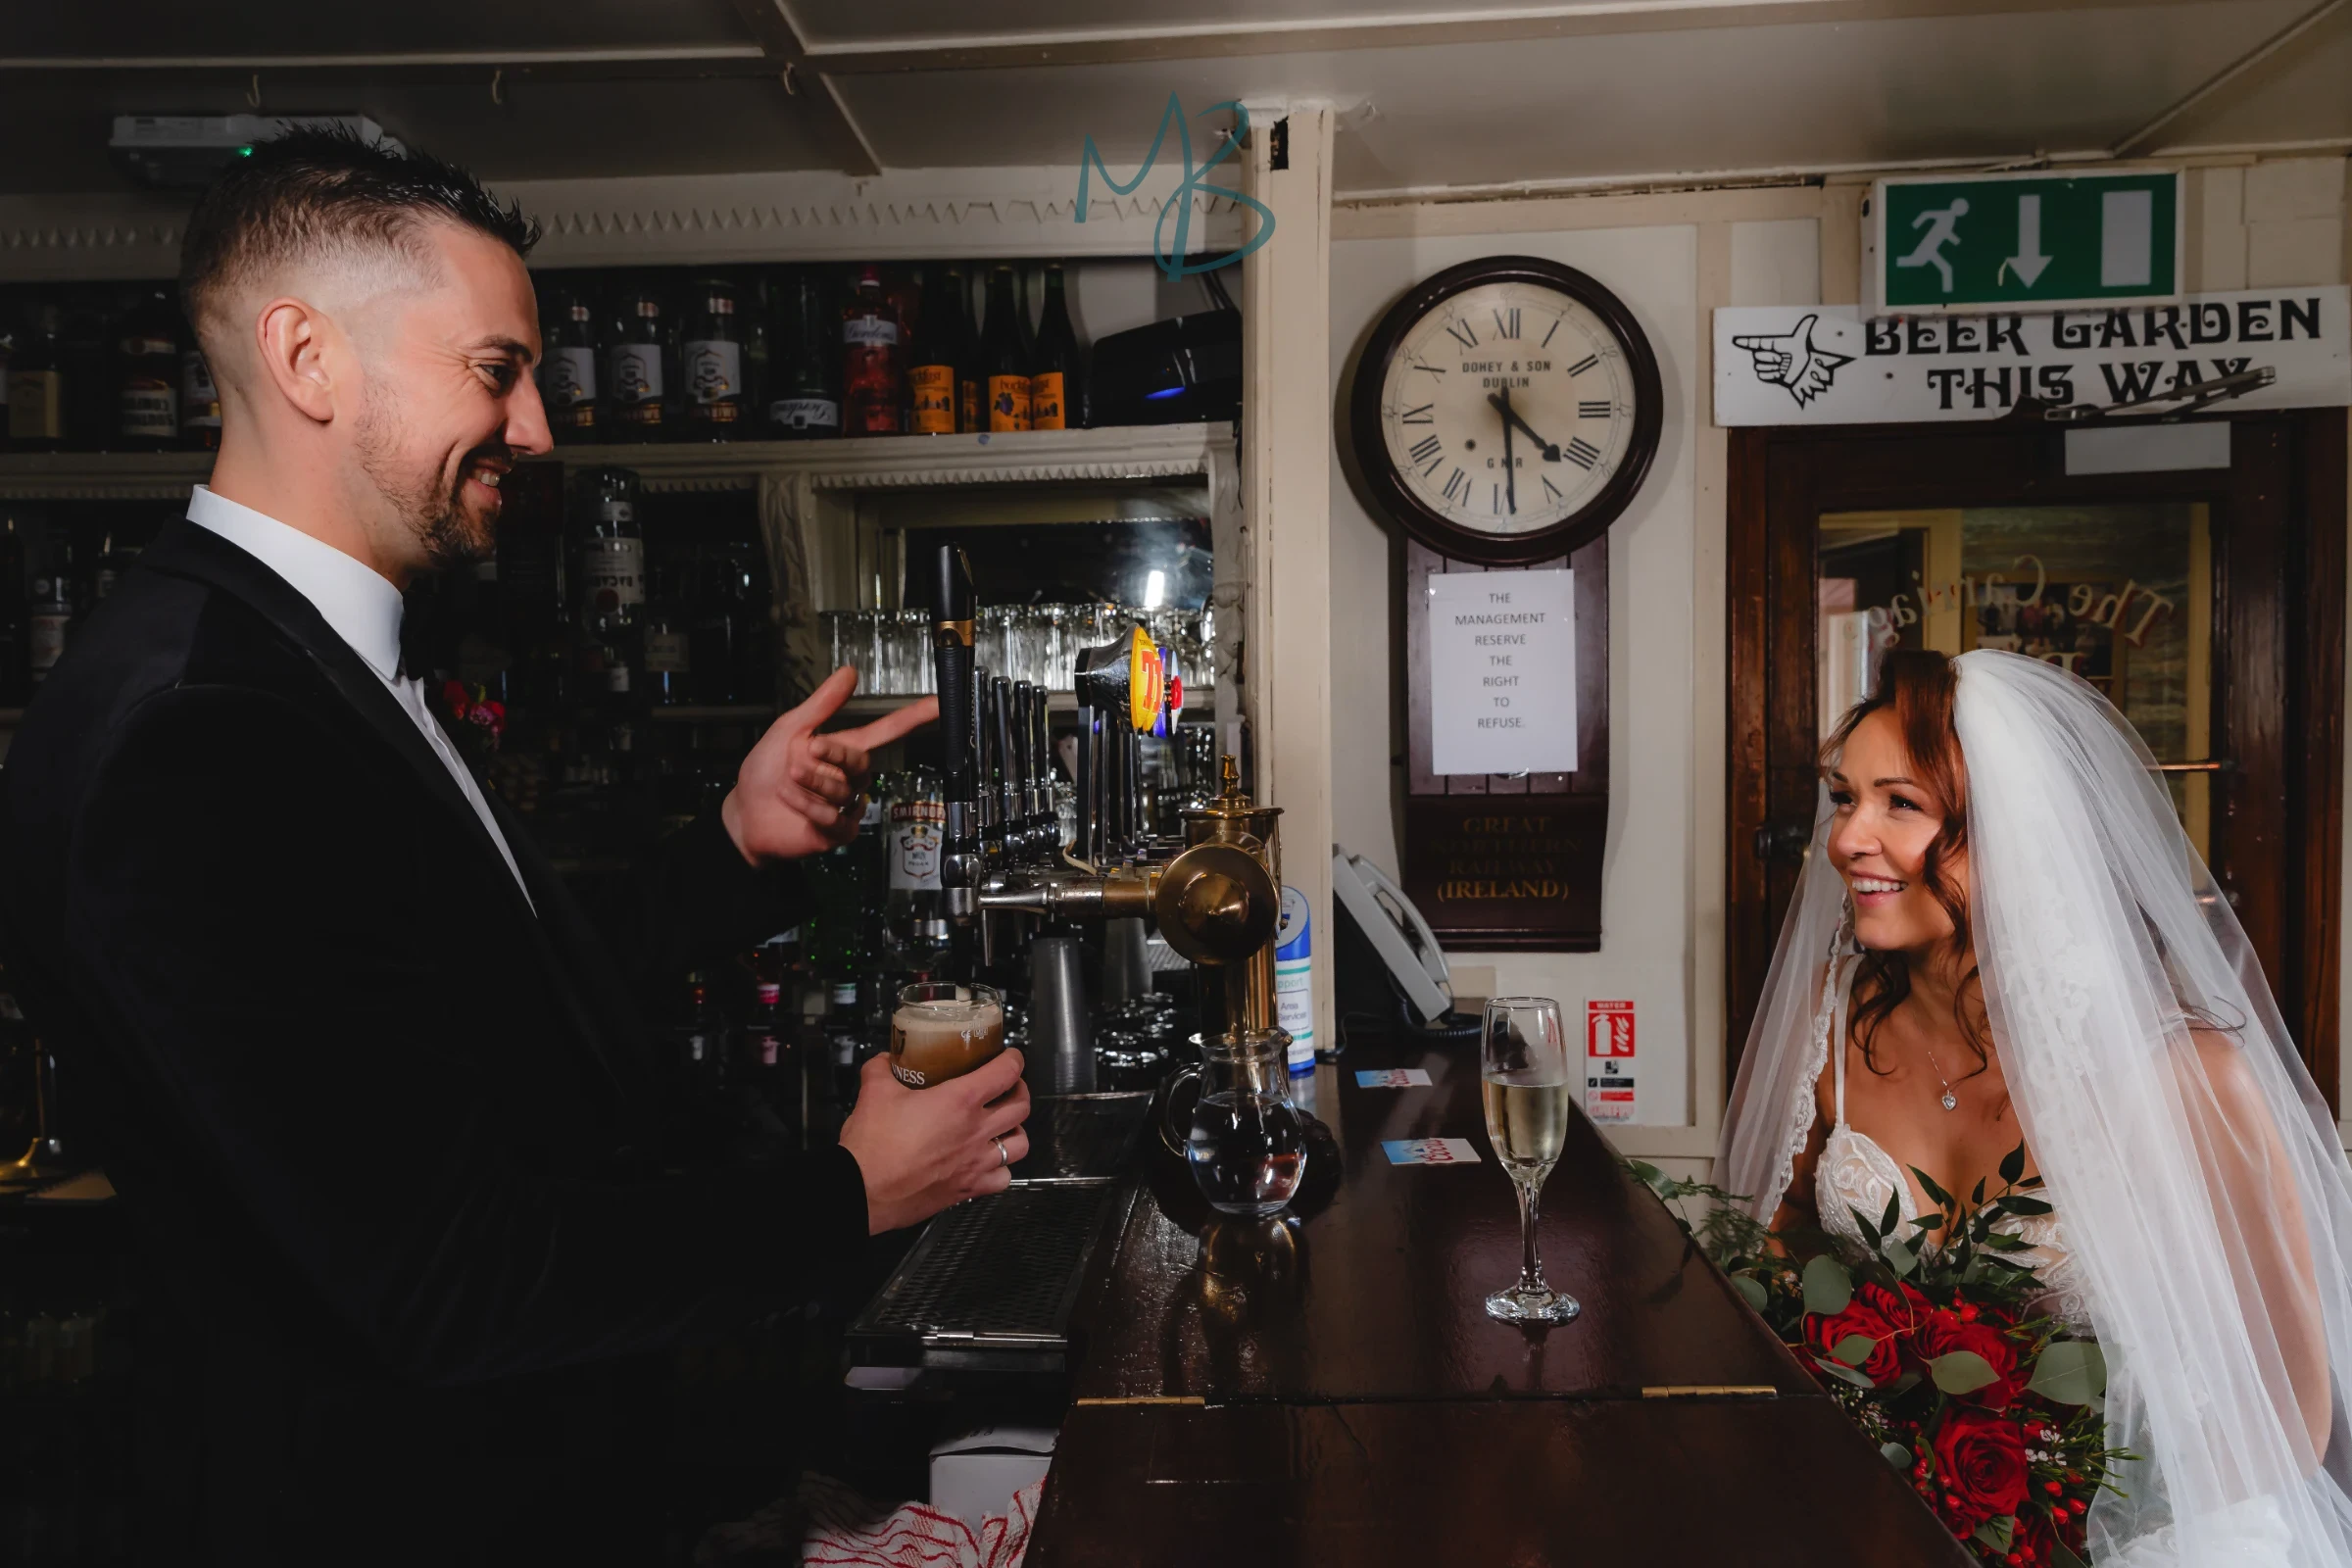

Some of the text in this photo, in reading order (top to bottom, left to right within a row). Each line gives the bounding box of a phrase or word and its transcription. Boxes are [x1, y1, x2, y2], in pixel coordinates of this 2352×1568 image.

[1864, 297, 2321, 357] BEER GARDEN
[1510, 362, 1520, 372] &
[1527, 361, 1551, 372] SON
[1483, 376, 1530, 389] DUBLIN
[1927, 357, 2252, 410] THIS WAY
[1489, 592, 1511, 604] THE
[1454, 612, 1545, 626] MANAGEMENT
[1474, 634, 1526, 646] RESERVE
[1490, 655, 1512, 666] THE
[1483, 675, 1519, 687] RIGHT
[1494, 697, 1510, 708] TO
[1462, 816, 1552, 834] GREAT
[1430, 838, 1585, 855] NORTHERN
[1448, 858, 1555, 875] RAILWAY
[1437, 879, 1570, 903] (IRELAND)
[1278, 976, 1303, 991] pport
